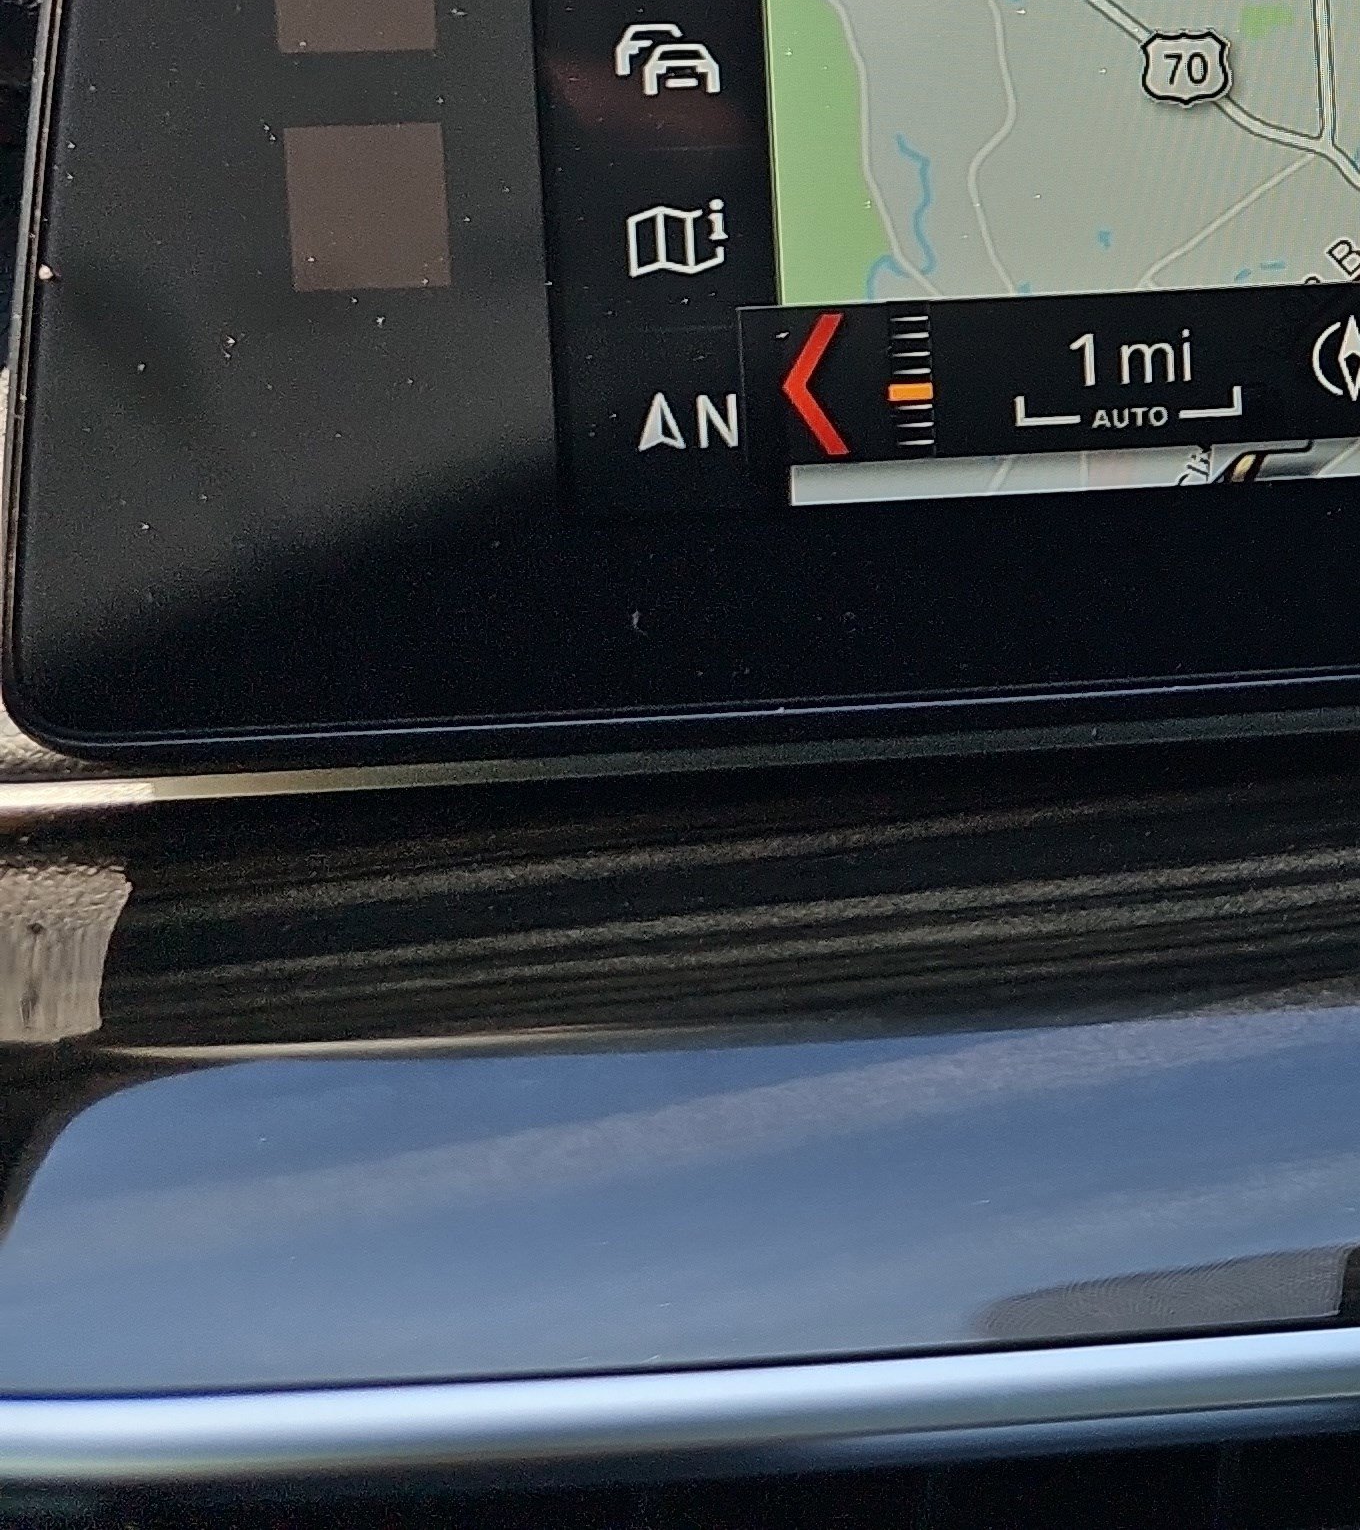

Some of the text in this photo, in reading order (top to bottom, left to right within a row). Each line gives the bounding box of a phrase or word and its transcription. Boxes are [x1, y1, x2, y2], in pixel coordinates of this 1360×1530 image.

[1164, 51, 1209, 85] 70
[1068, 328, 1192, 387] 1 mi
[1091, 405, 1169, 429] AUTO
